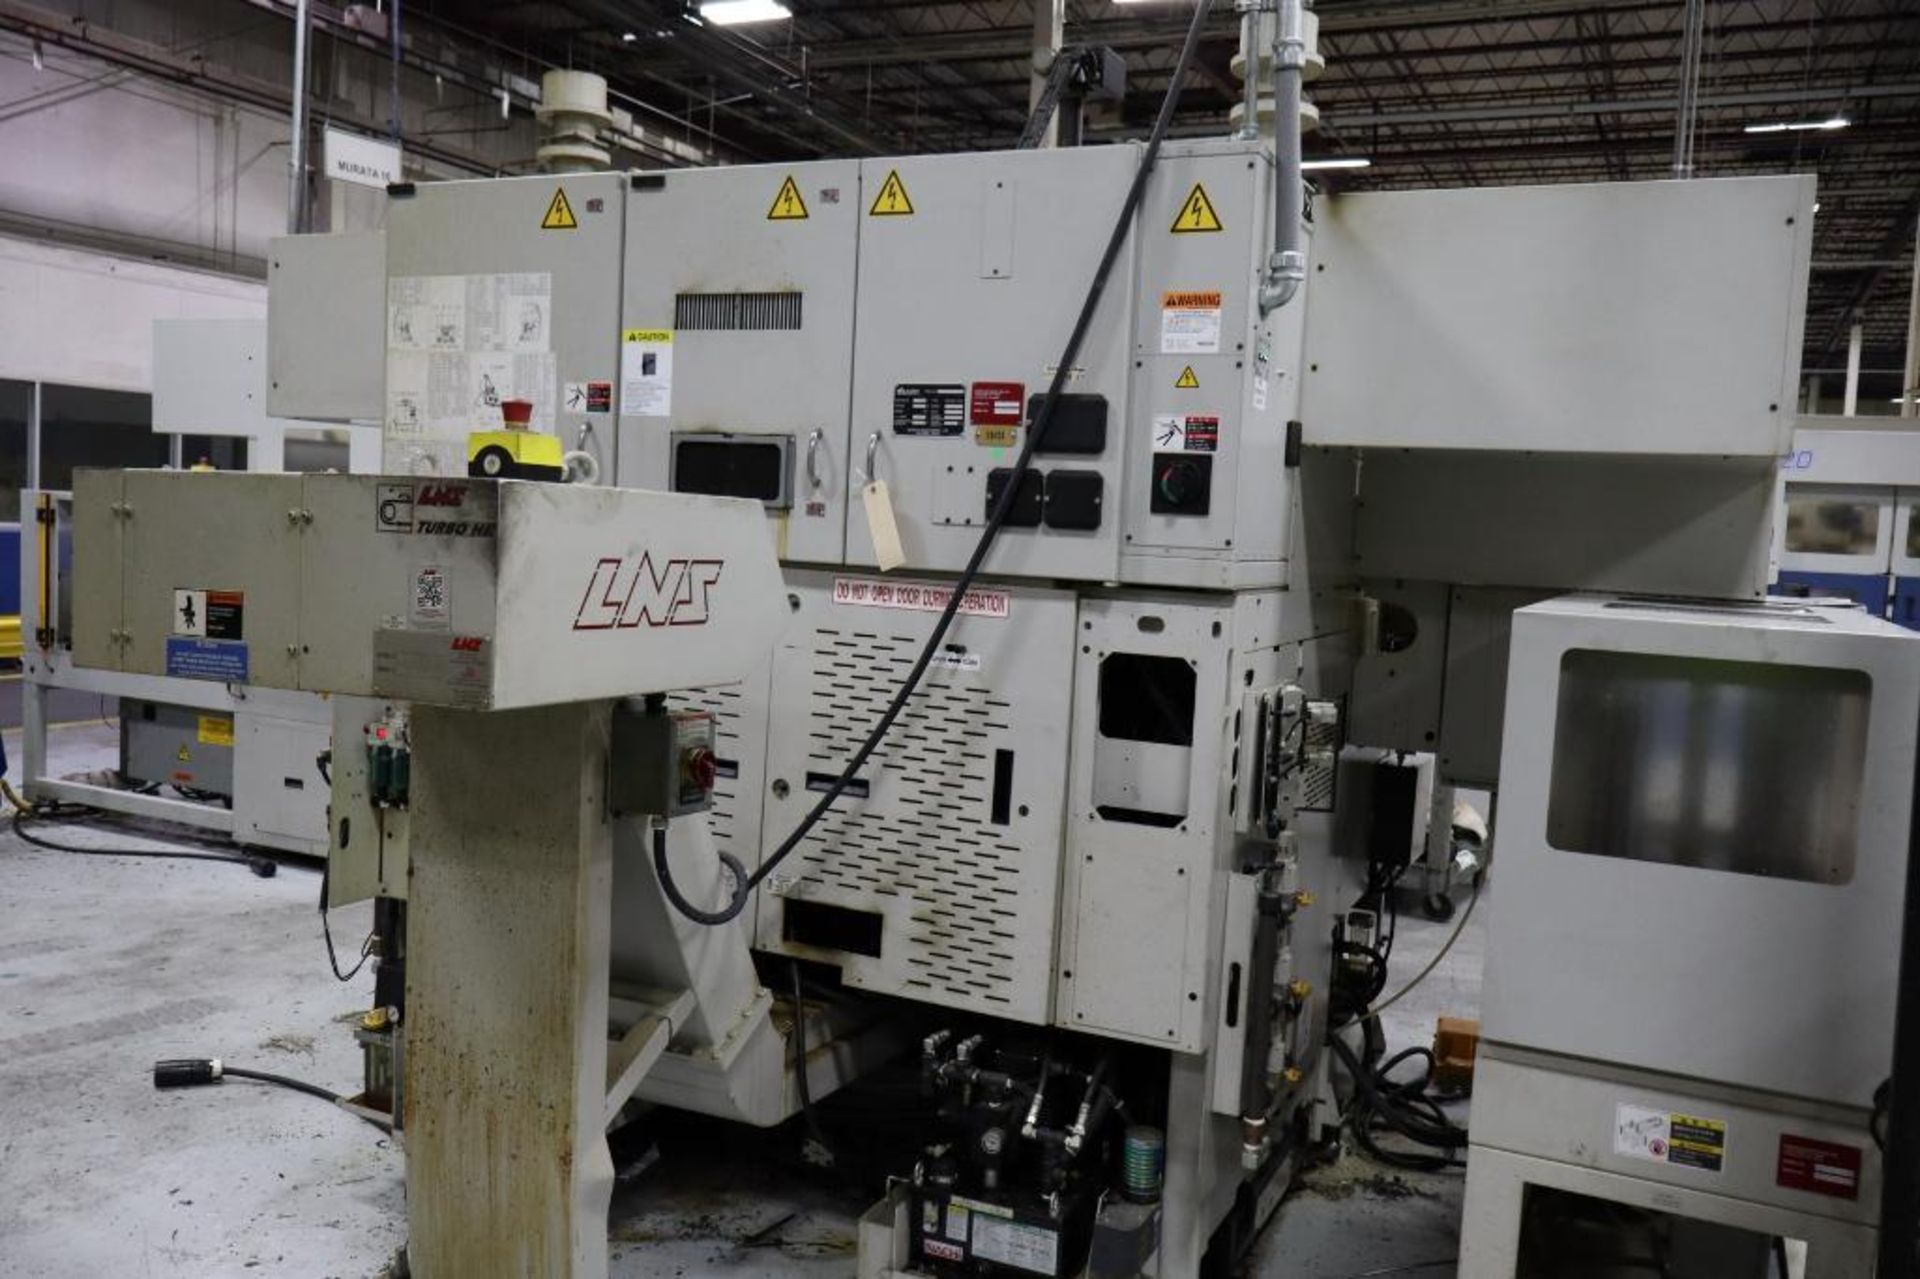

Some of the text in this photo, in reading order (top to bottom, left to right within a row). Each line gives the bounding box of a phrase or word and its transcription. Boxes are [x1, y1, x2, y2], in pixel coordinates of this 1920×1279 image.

[338, 160, 379, 178] MURATA
[1178, 294, 1219, 306] WARNING
[637, 332, 670, 342] CAUTION
[417, 521, 468, 536] TURBO
[573, 549, 724, 631] LNS
[836, 582, 850, 600] DO
[851, 583, 869, 601] NOT
[871, 583, 895, 603] OPEN
[896, 587, 921, 605] DOOR
